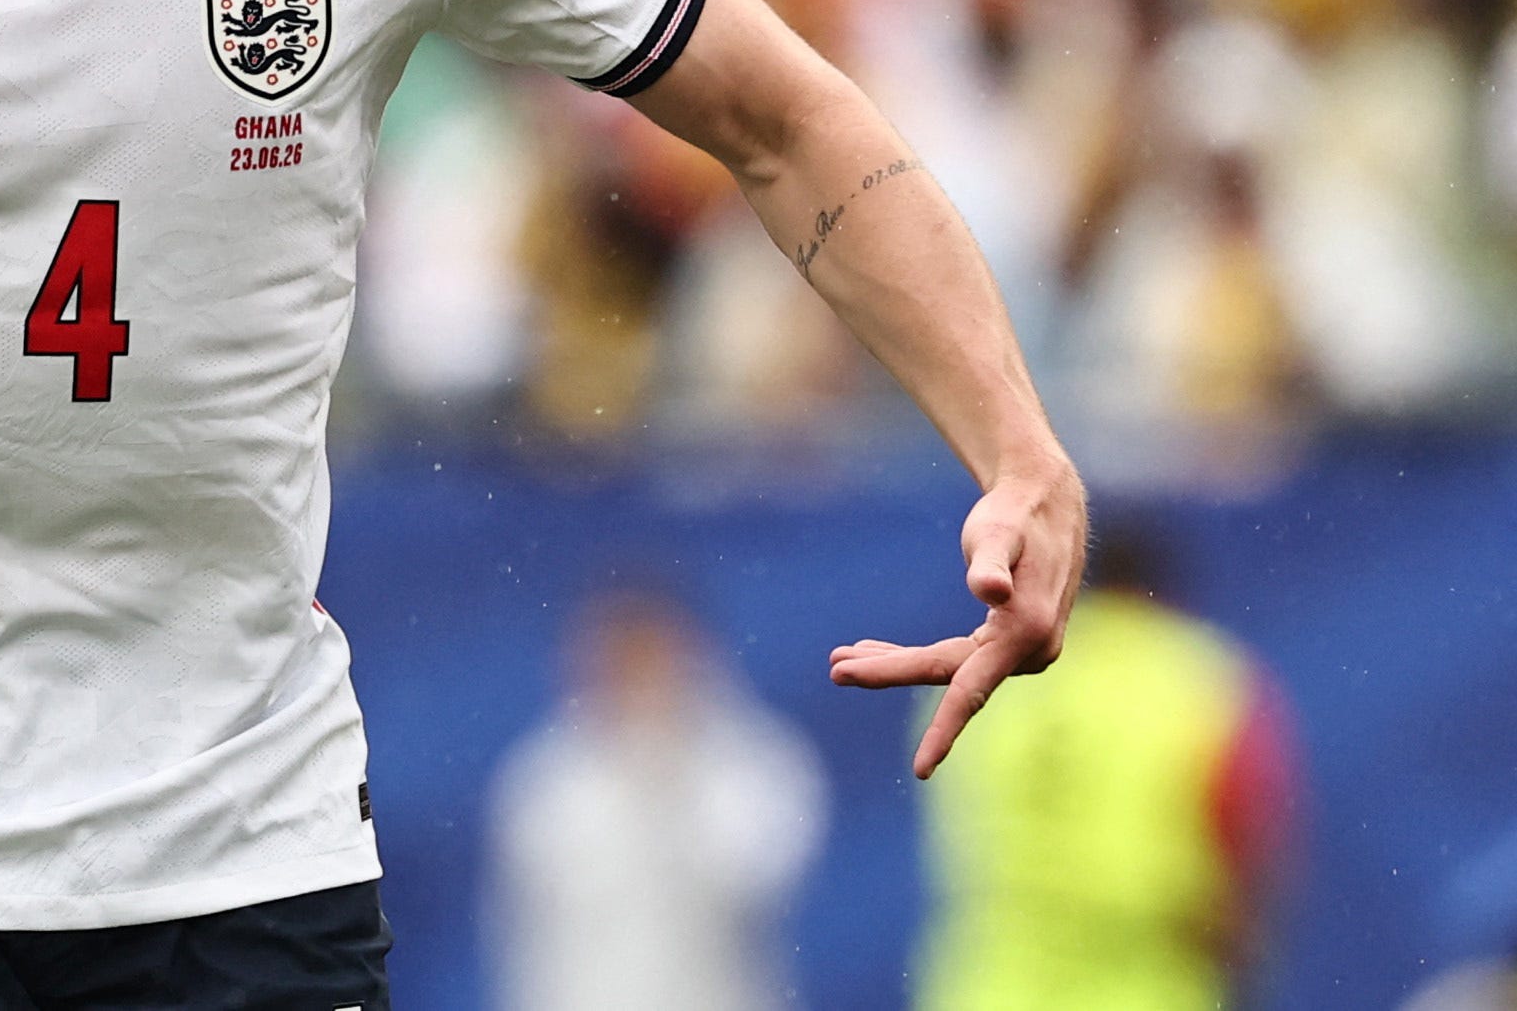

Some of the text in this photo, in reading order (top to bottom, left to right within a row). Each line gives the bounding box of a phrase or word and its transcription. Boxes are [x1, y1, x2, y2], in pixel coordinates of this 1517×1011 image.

[235, 112, 303, 140] GHANA
[230, 142, 303, 172] 23.06.26
[862, 158, 926, 190] 07.08.
[23, 199, 130, 402] 4
